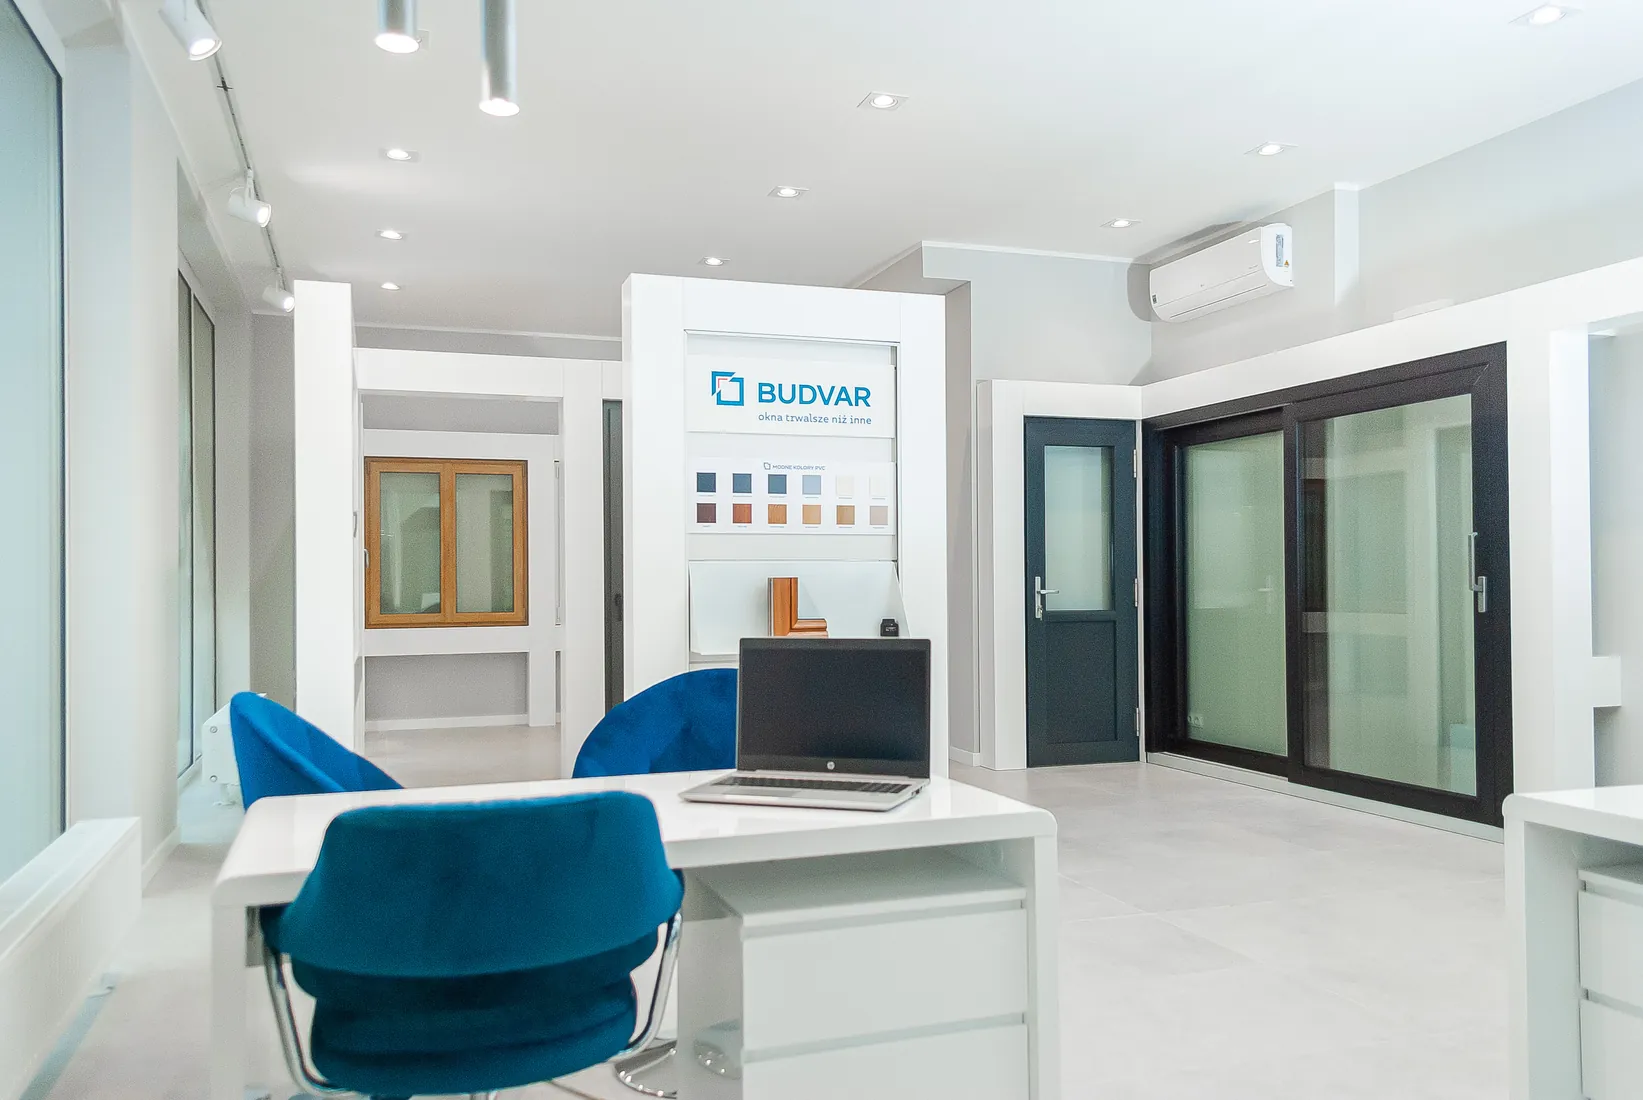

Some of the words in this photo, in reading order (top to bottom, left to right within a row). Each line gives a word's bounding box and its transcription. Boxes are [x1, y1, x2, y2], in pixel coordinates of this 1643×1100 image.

[758, 382, 871, 407] BUDVAR
[758, 412, 783, 422] okna
[786, 413, 829, 424] trwalsze
[832, 414, 847, 424] niż
[850, 415, 872, 425] inne
